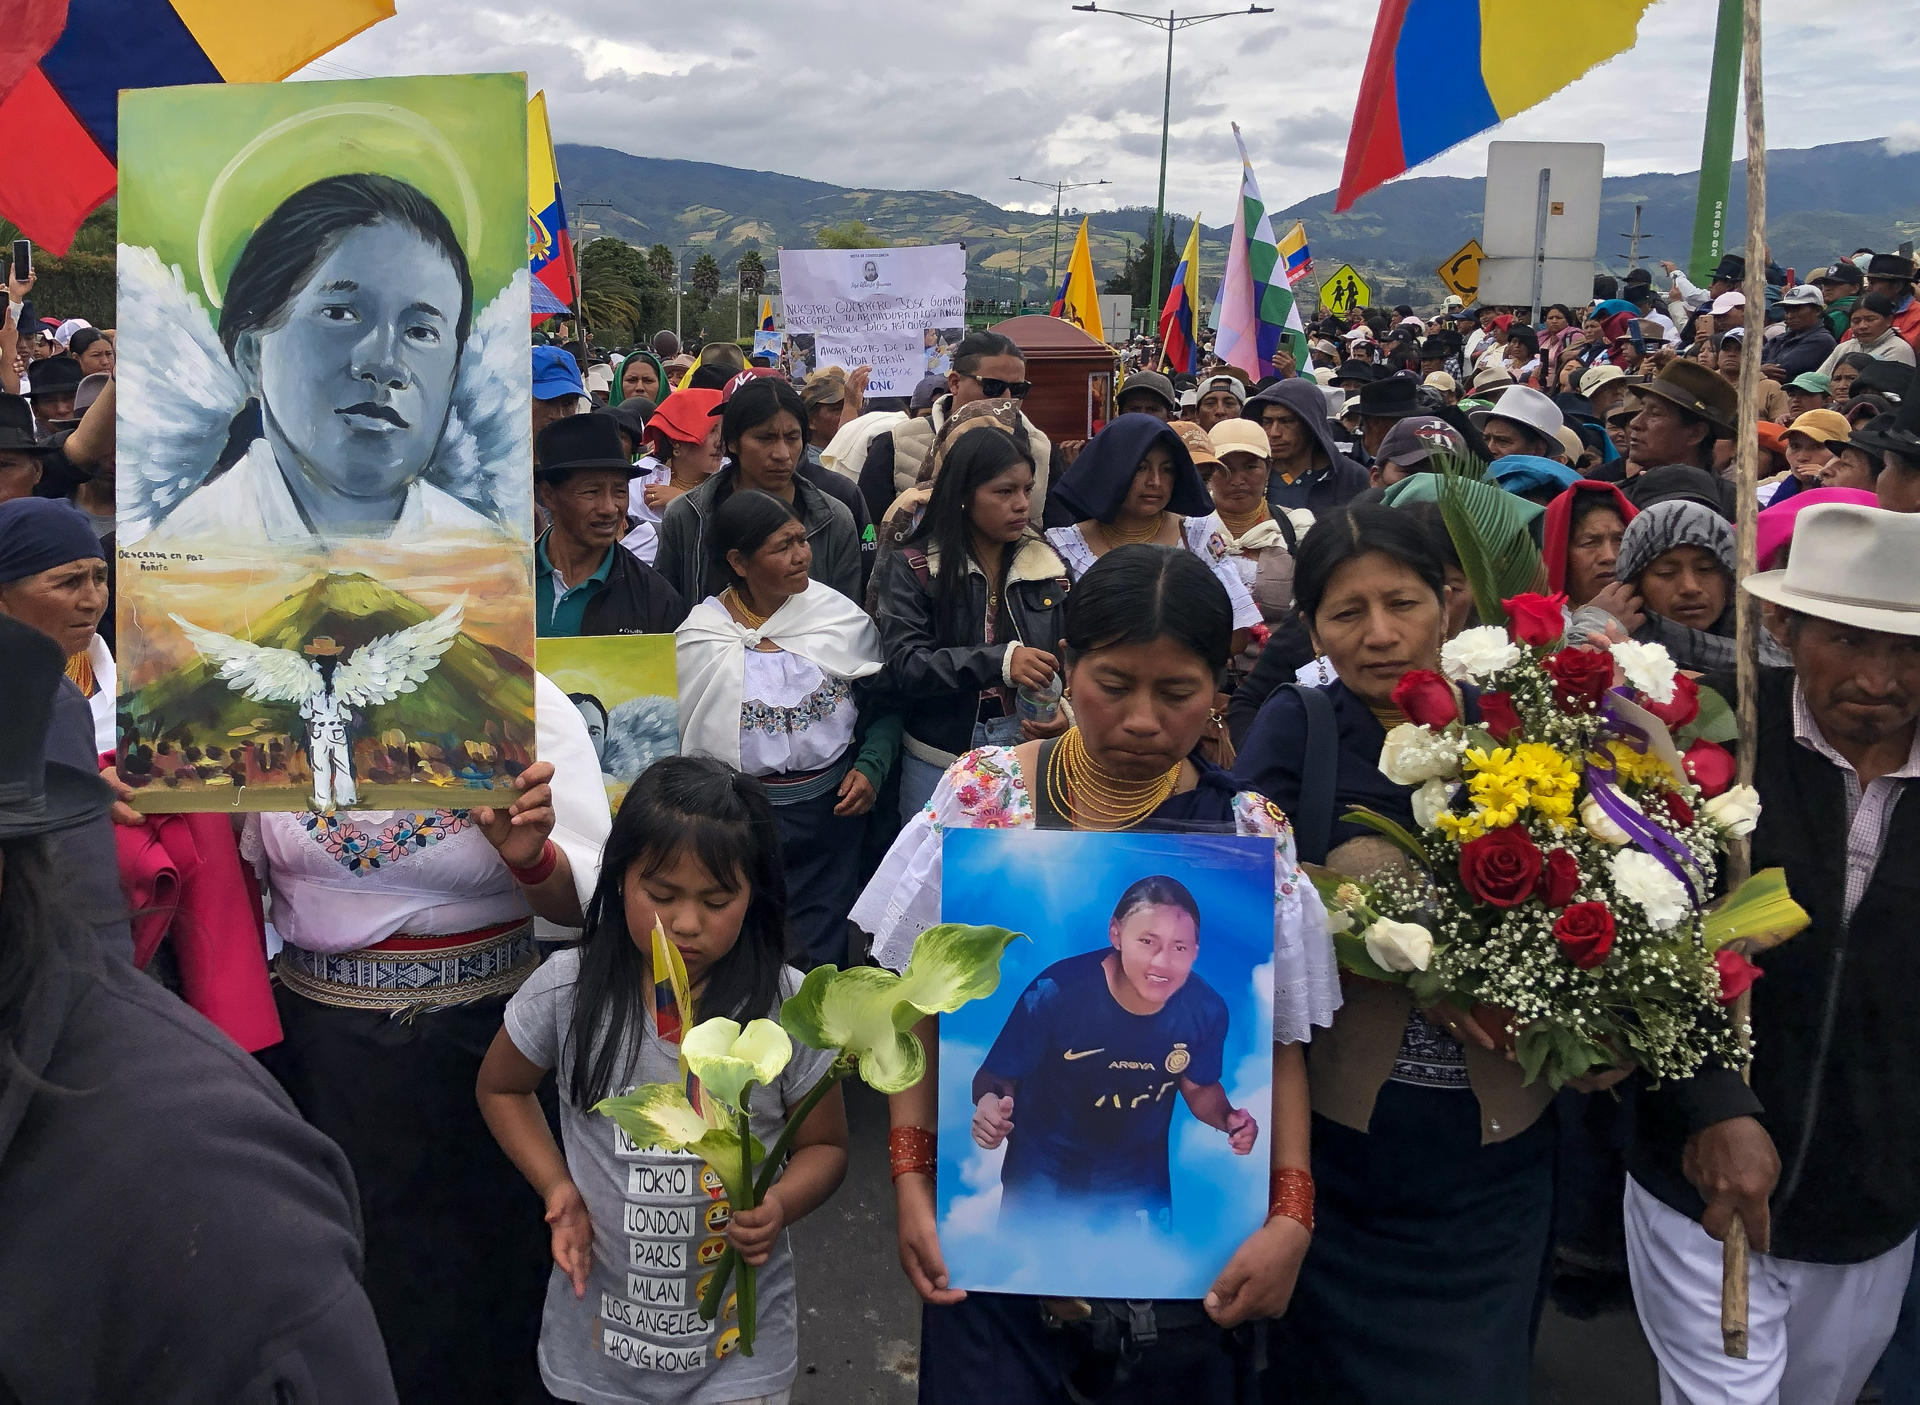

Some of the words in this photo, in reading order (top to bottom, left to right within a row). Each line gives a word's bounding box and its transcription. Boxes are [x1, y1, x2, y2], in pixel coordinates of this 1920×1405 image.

[786, 303, 830, 316] NUESTRO
[836, 300, 891, 314] GUERRERO
[635, 1167, 686, 1194] TOKYO
[628, 1206, 690, 1235] LONDON
[635, 1242, 681, 1268] PARIS
[632, 1278, 680, 1303] MILAN
[606, 1296, 632, 1326] LOS
[635, 1308, 709, 1336] ANGELES
[609, 1335, 651, 1369] HONG
[655, 1350, 701, 1372] KONG
